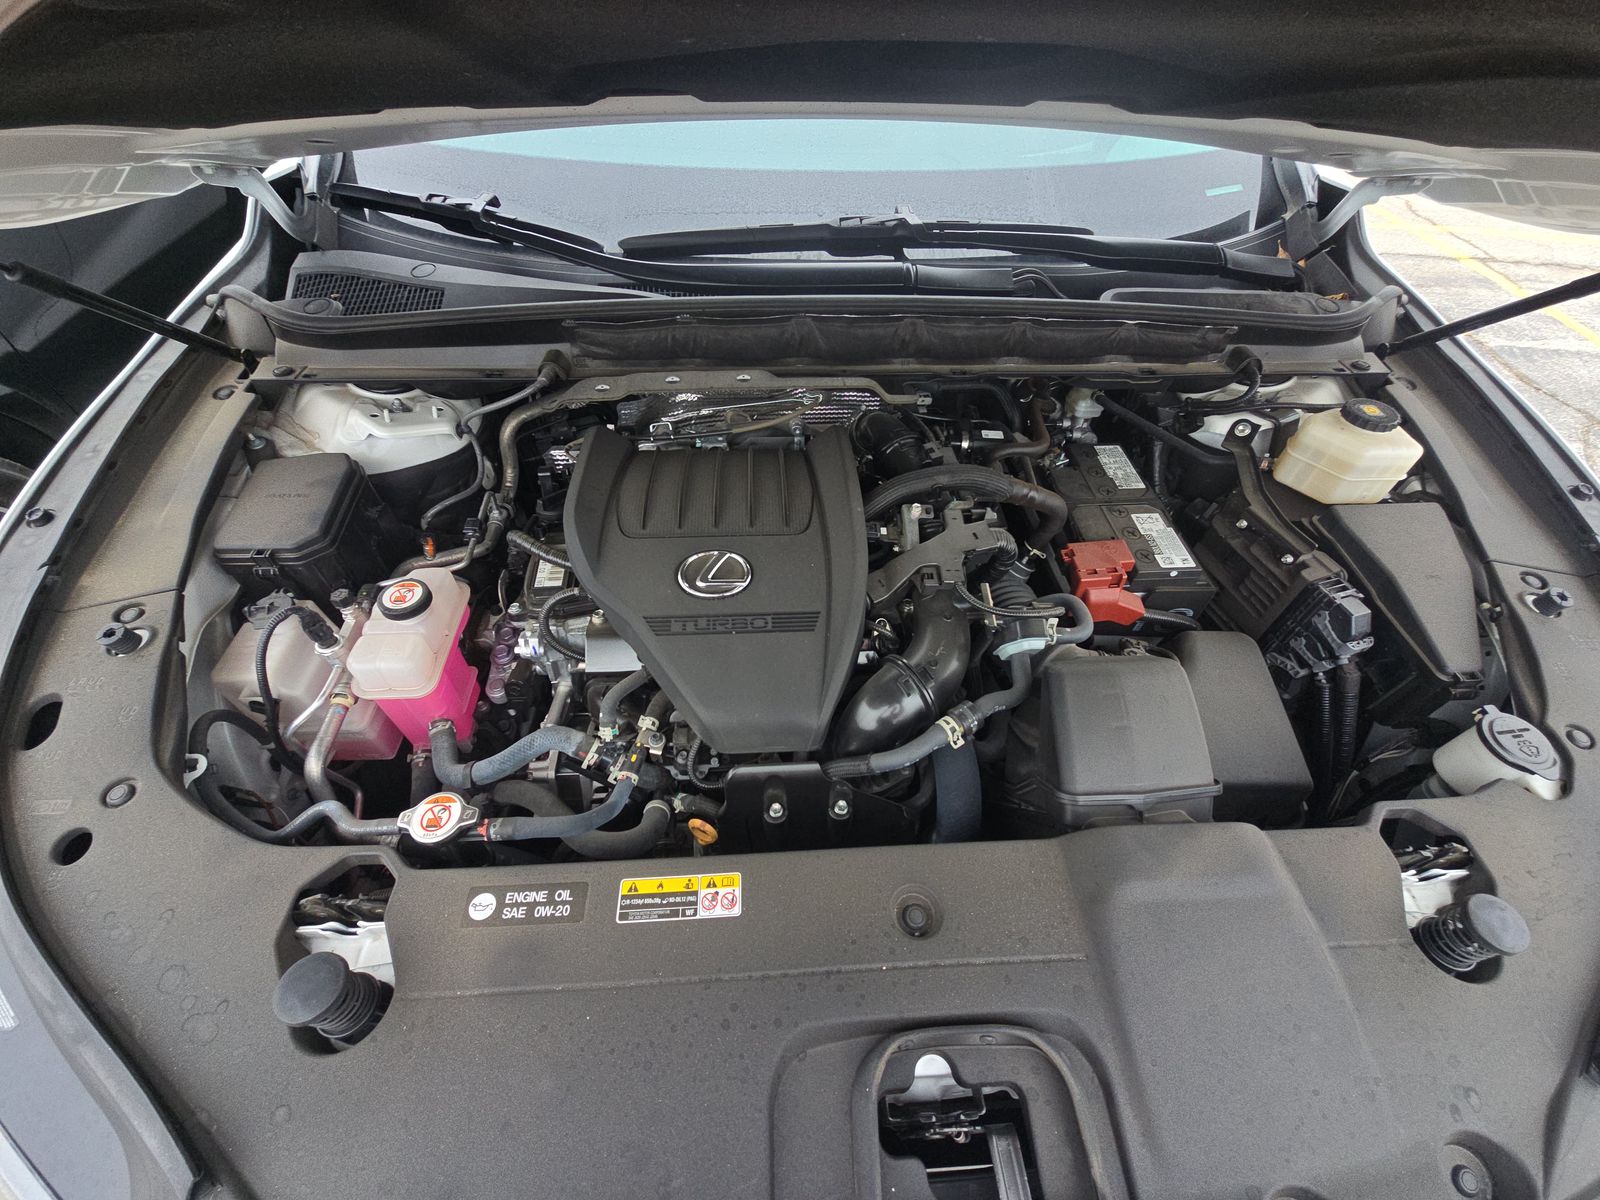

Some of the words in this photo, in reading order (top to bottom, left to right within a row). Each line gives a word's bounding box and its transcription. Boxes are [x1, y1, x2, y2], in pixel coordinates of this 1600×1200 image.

[673, 616, 770, 632] TURBO
[505, 890, 549, 903] ENGINE
[554, 889, 574, 901] OIL
[501, 906, 527, 919] SAE
[534, 905, 570, 918] 0W-20
